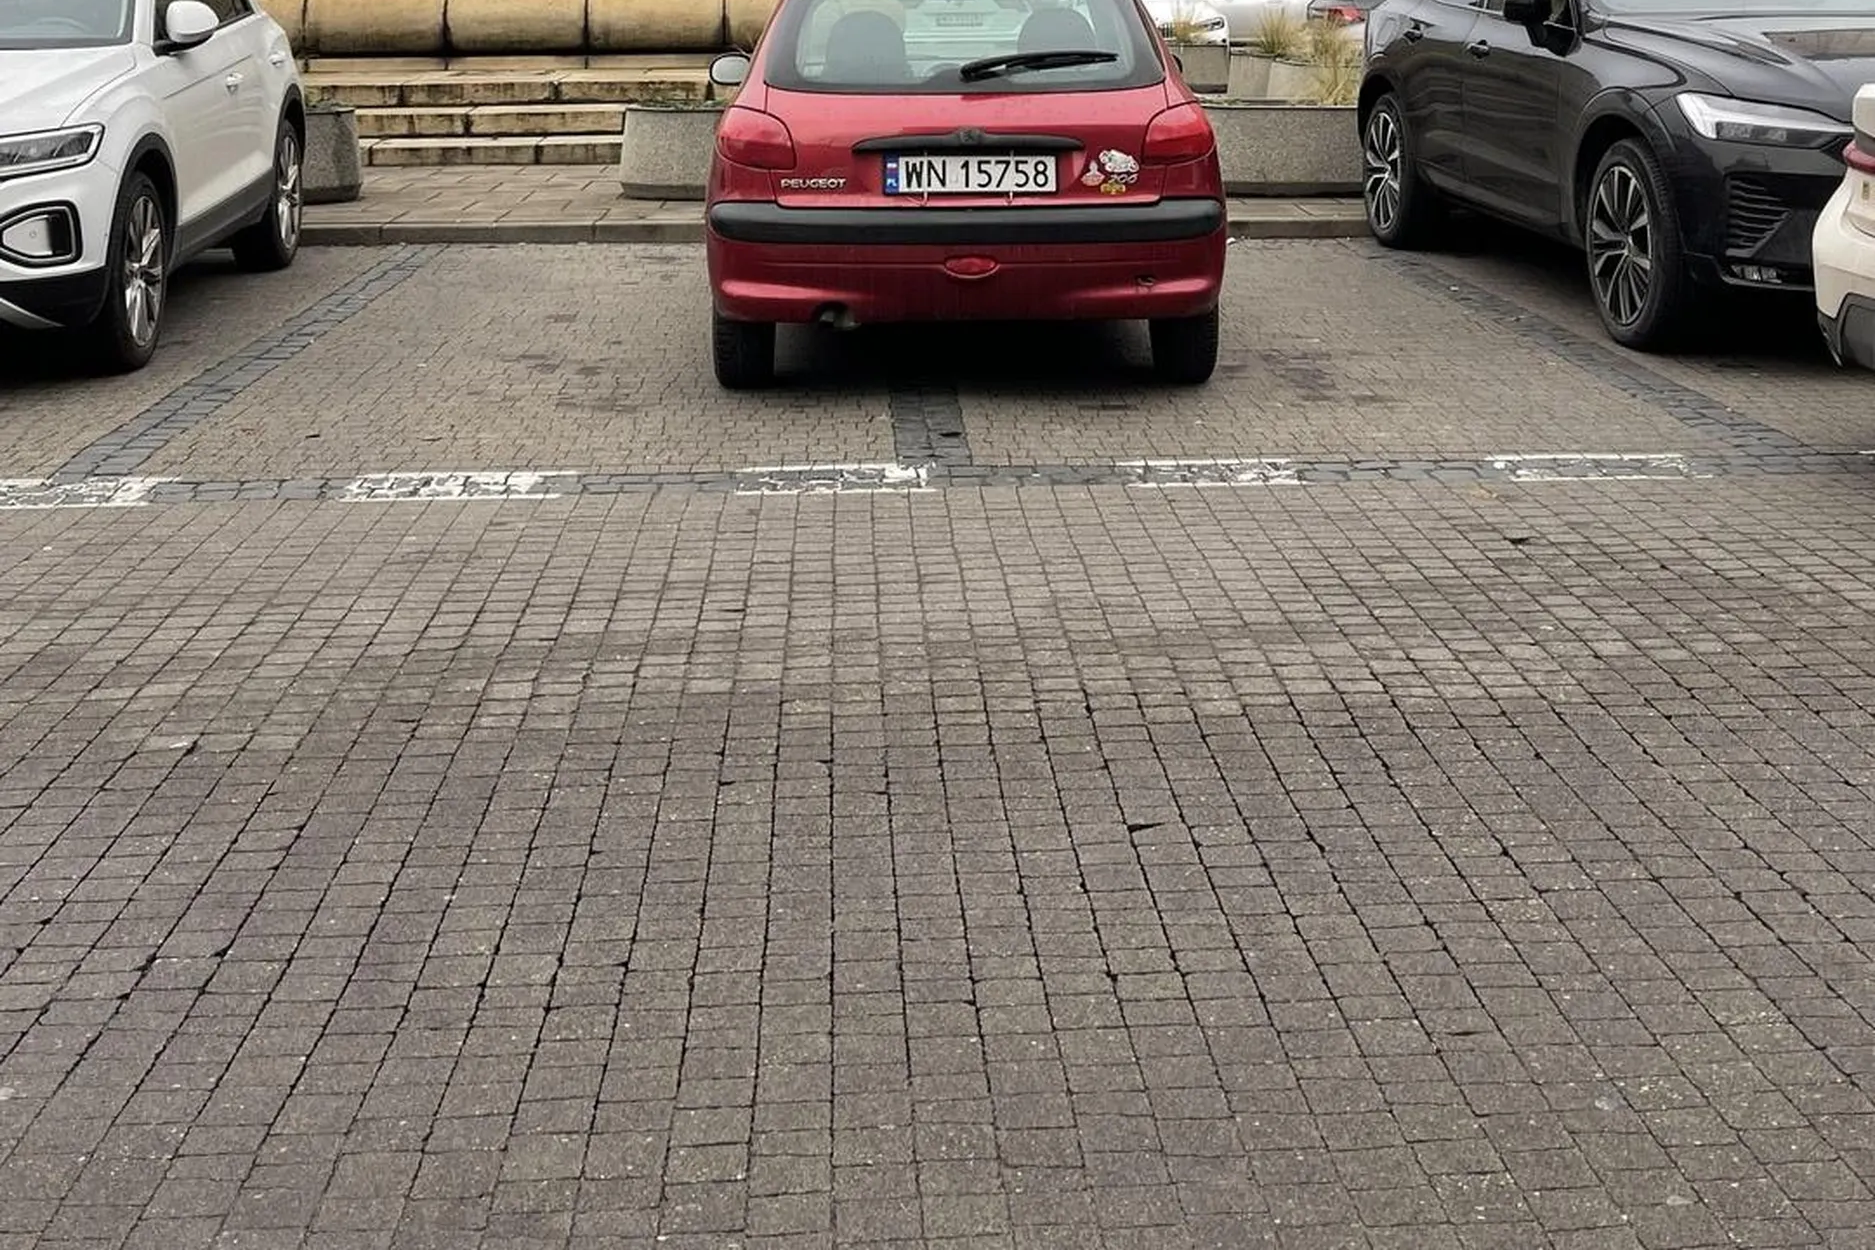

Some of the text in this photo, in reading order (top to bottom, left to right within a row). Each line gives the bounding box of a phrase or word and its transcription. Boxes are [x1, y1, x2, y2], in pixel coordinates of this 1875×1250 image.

[781, 177, 847, 188] PEUGEOT
[905, 159, 1049, 188] WN 15758
